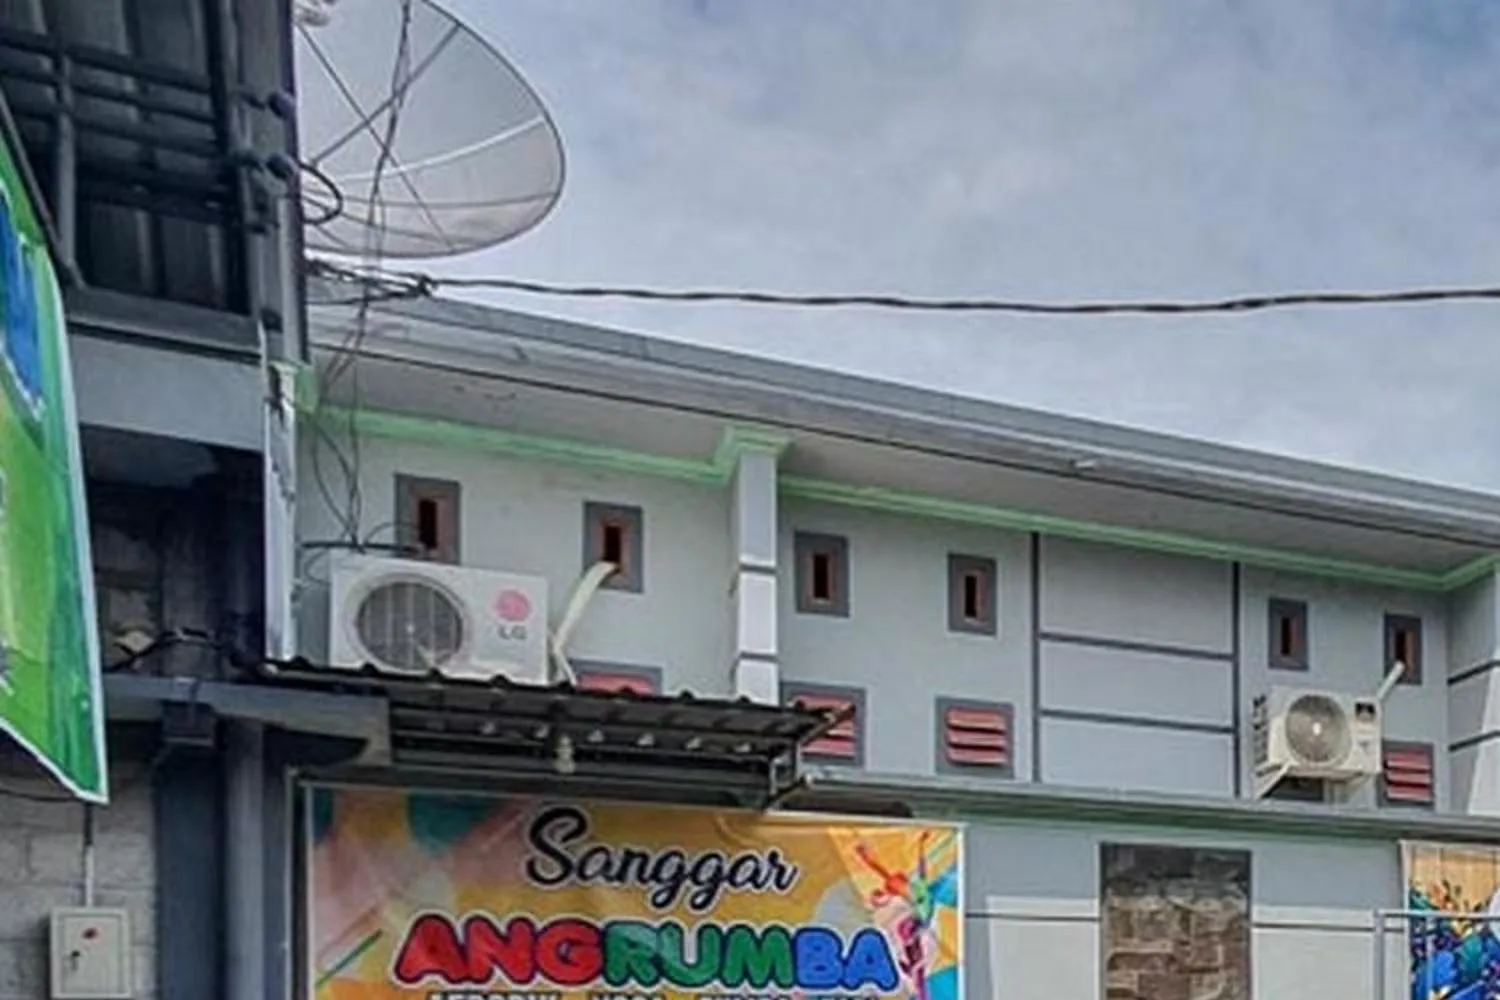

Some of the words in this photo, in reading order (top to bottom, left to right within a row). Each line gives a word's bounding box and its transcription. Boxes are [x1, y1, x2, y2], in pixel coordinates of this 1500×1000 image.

[498, 624, 527, 641] LG
[525, 806, 799, 908] Sanggar
[394, 915, 899, 990] ANGRUMBA
